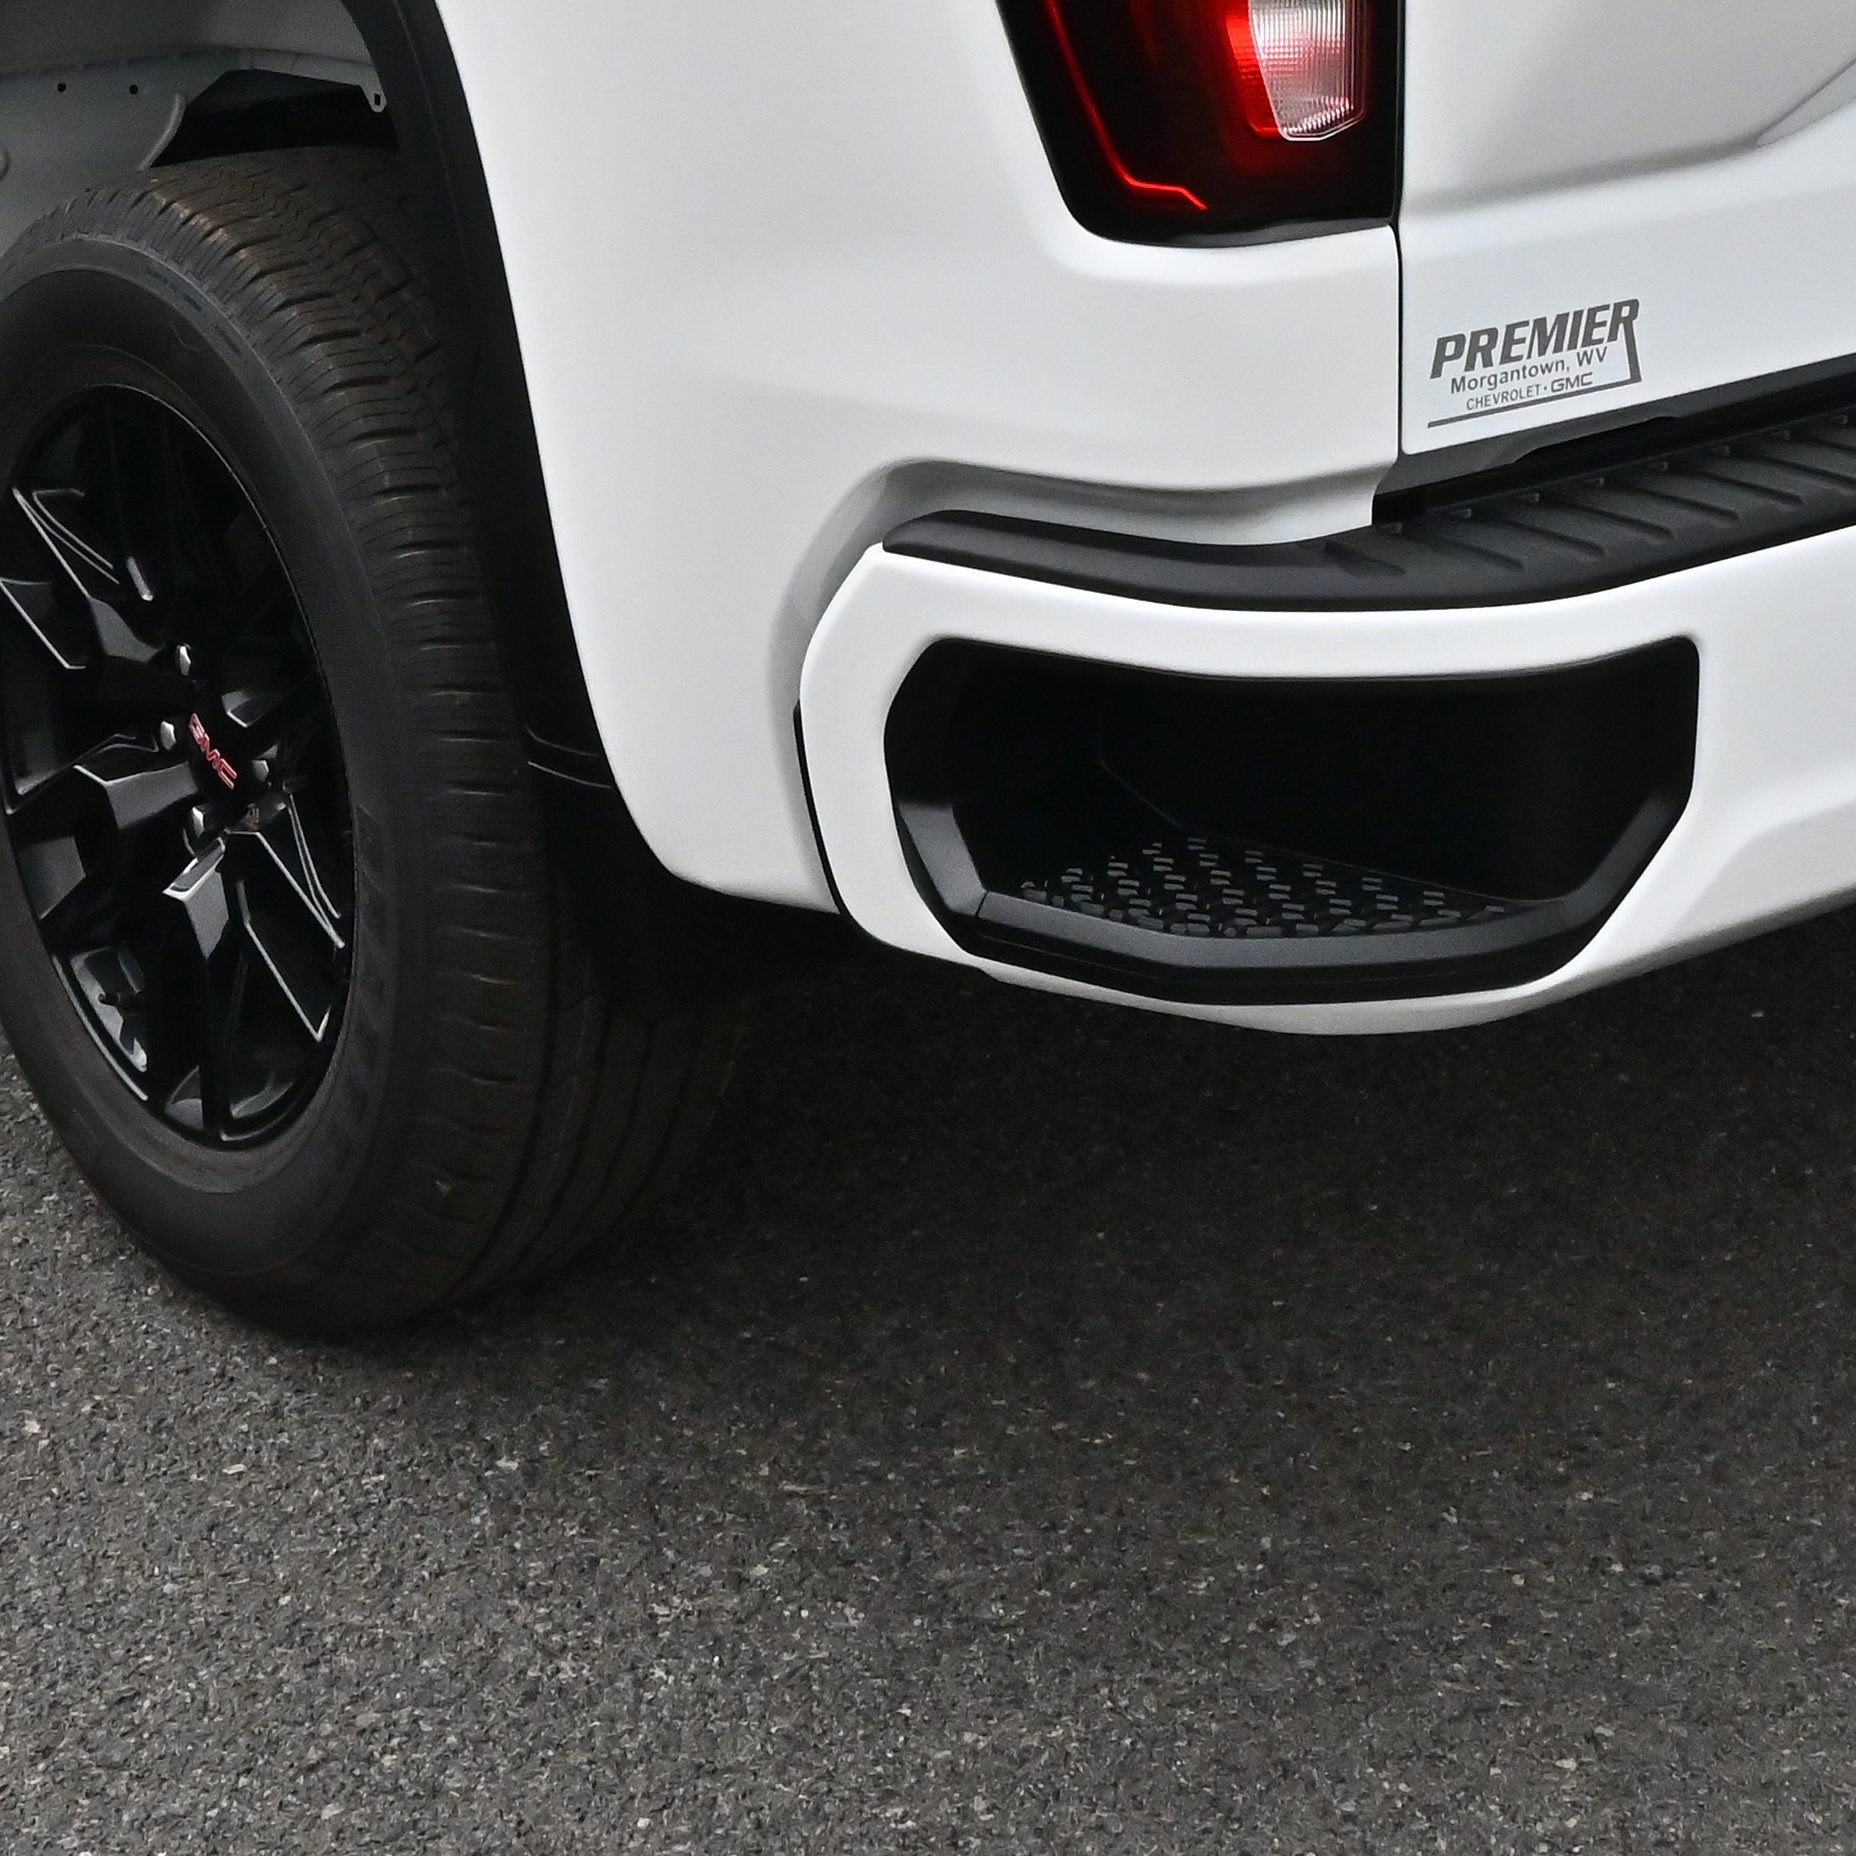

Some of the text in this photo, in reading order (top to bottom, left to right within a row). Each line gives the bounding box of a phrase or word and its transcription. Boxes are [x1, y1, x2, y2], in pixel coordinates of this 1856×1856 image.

[1429, 298, 1642, 380] PREMIER
[1450, 346, 1608, 395] Morgantown, WV
[1466, 371, 1594, 411] CHEVROLET GMC
[189, 712, 238, 789] GMC
